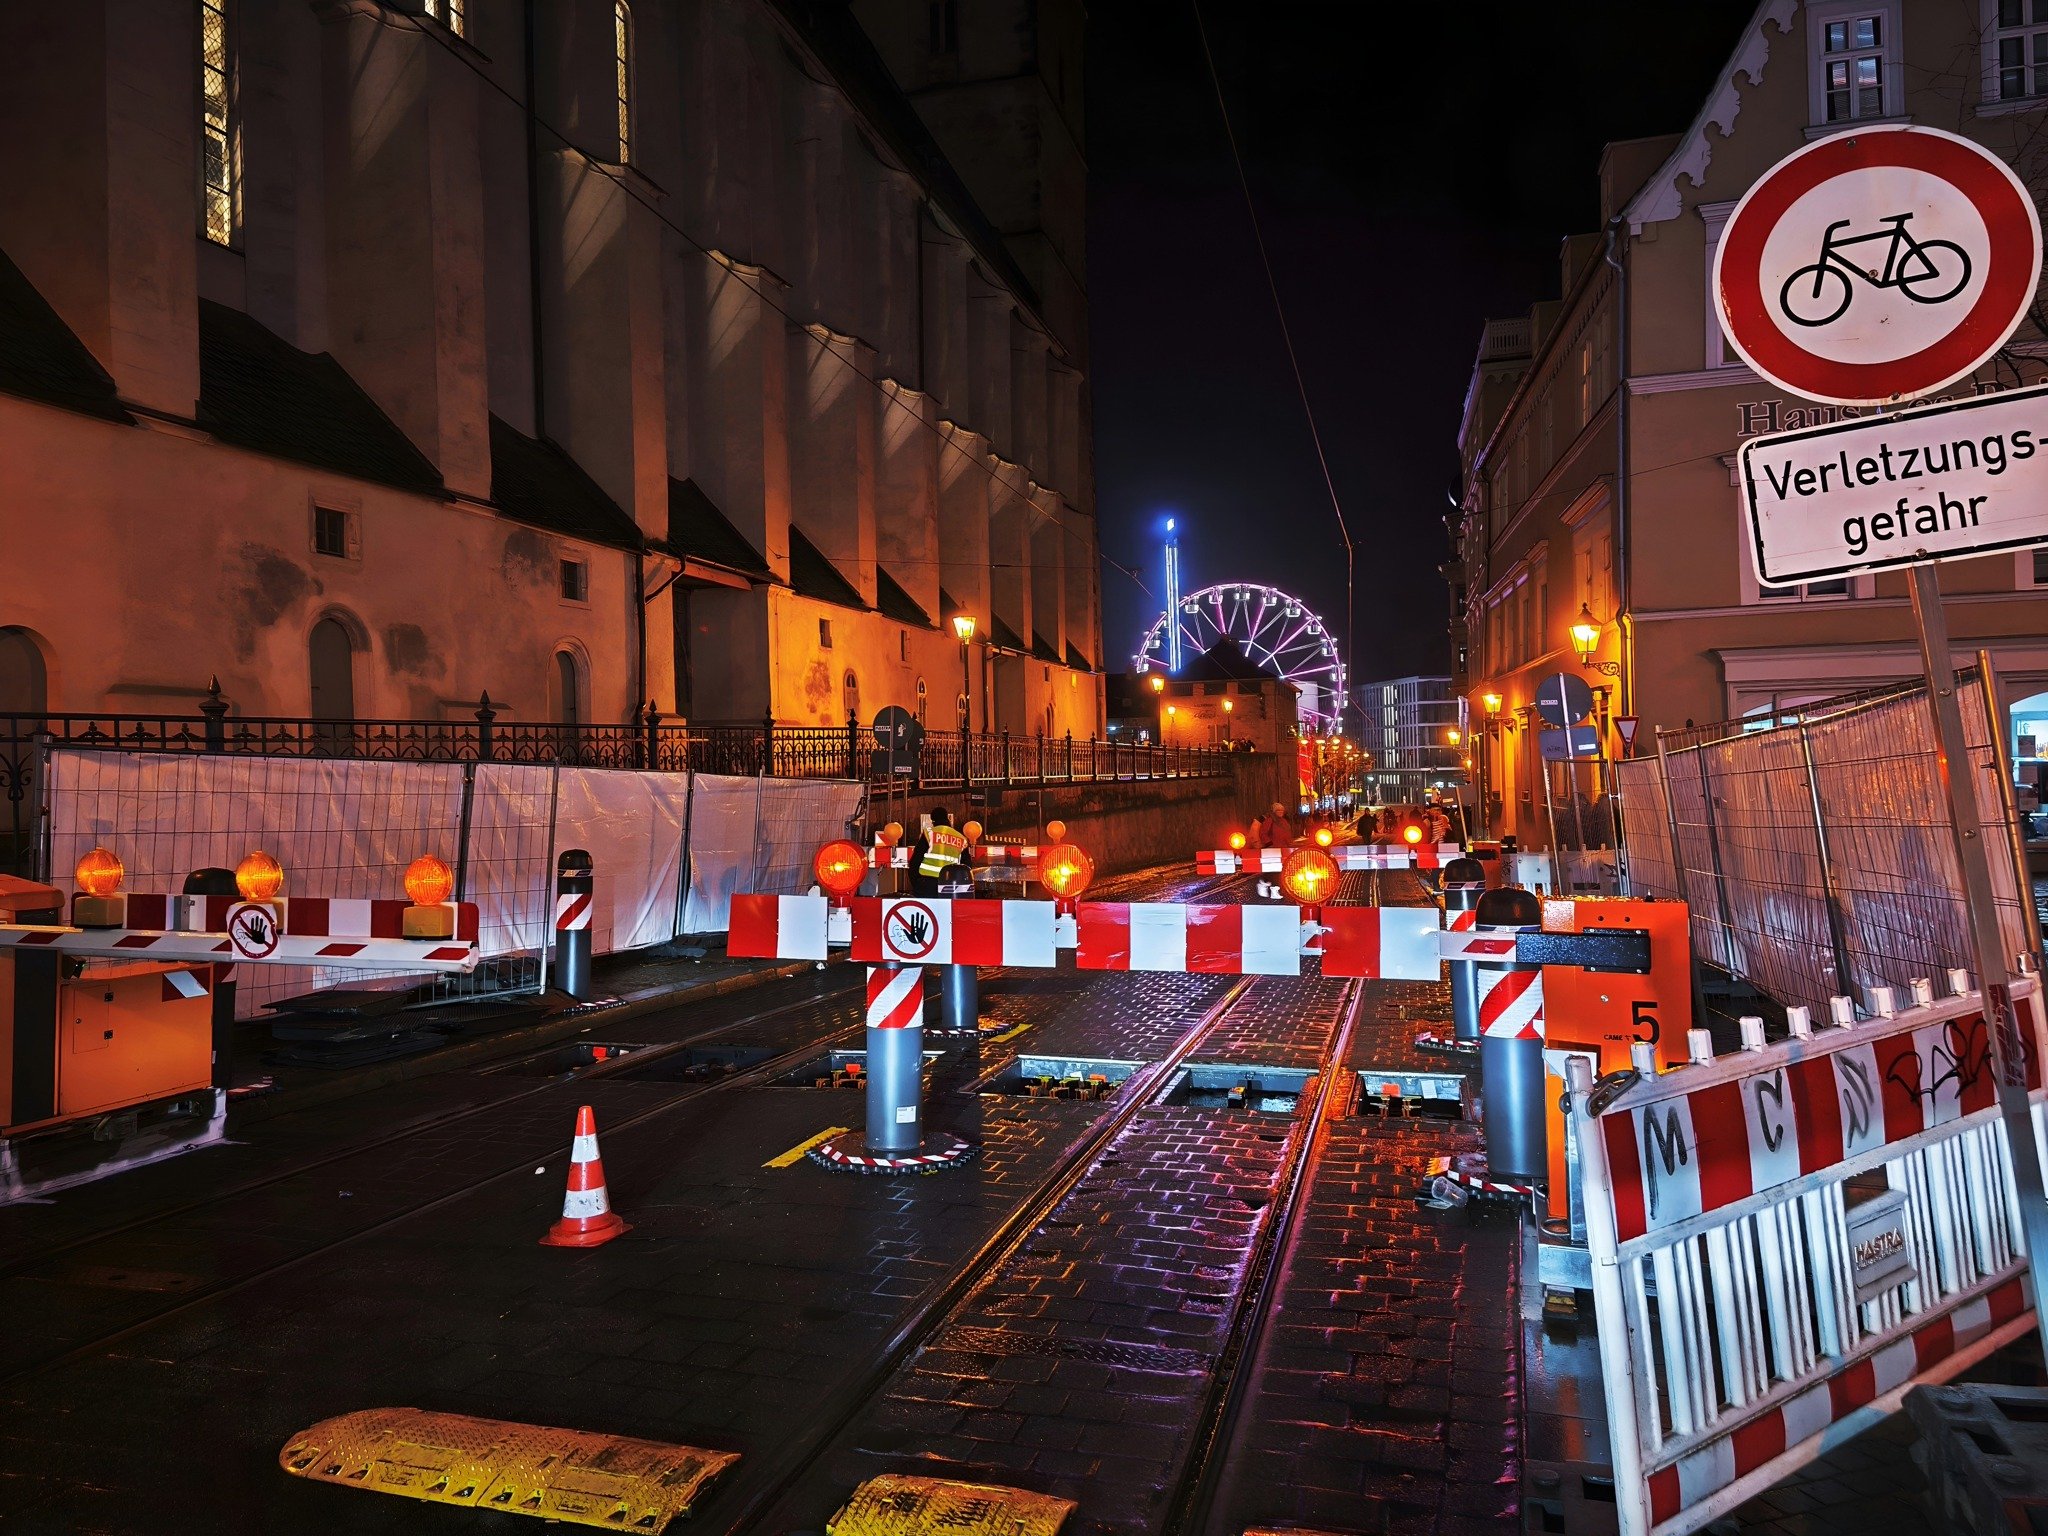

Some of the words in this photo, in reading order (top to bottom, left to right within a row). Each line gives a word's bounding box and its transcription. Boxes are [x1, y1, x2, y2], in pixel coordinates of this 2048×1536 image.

[1763, 429, 2048, 500] Verletzungs-
[1843, 491, 1988, 556] gefahr
[935, 832, 962, 848] POLIZEI
[1631, 1000, 1660, 1045] 5
